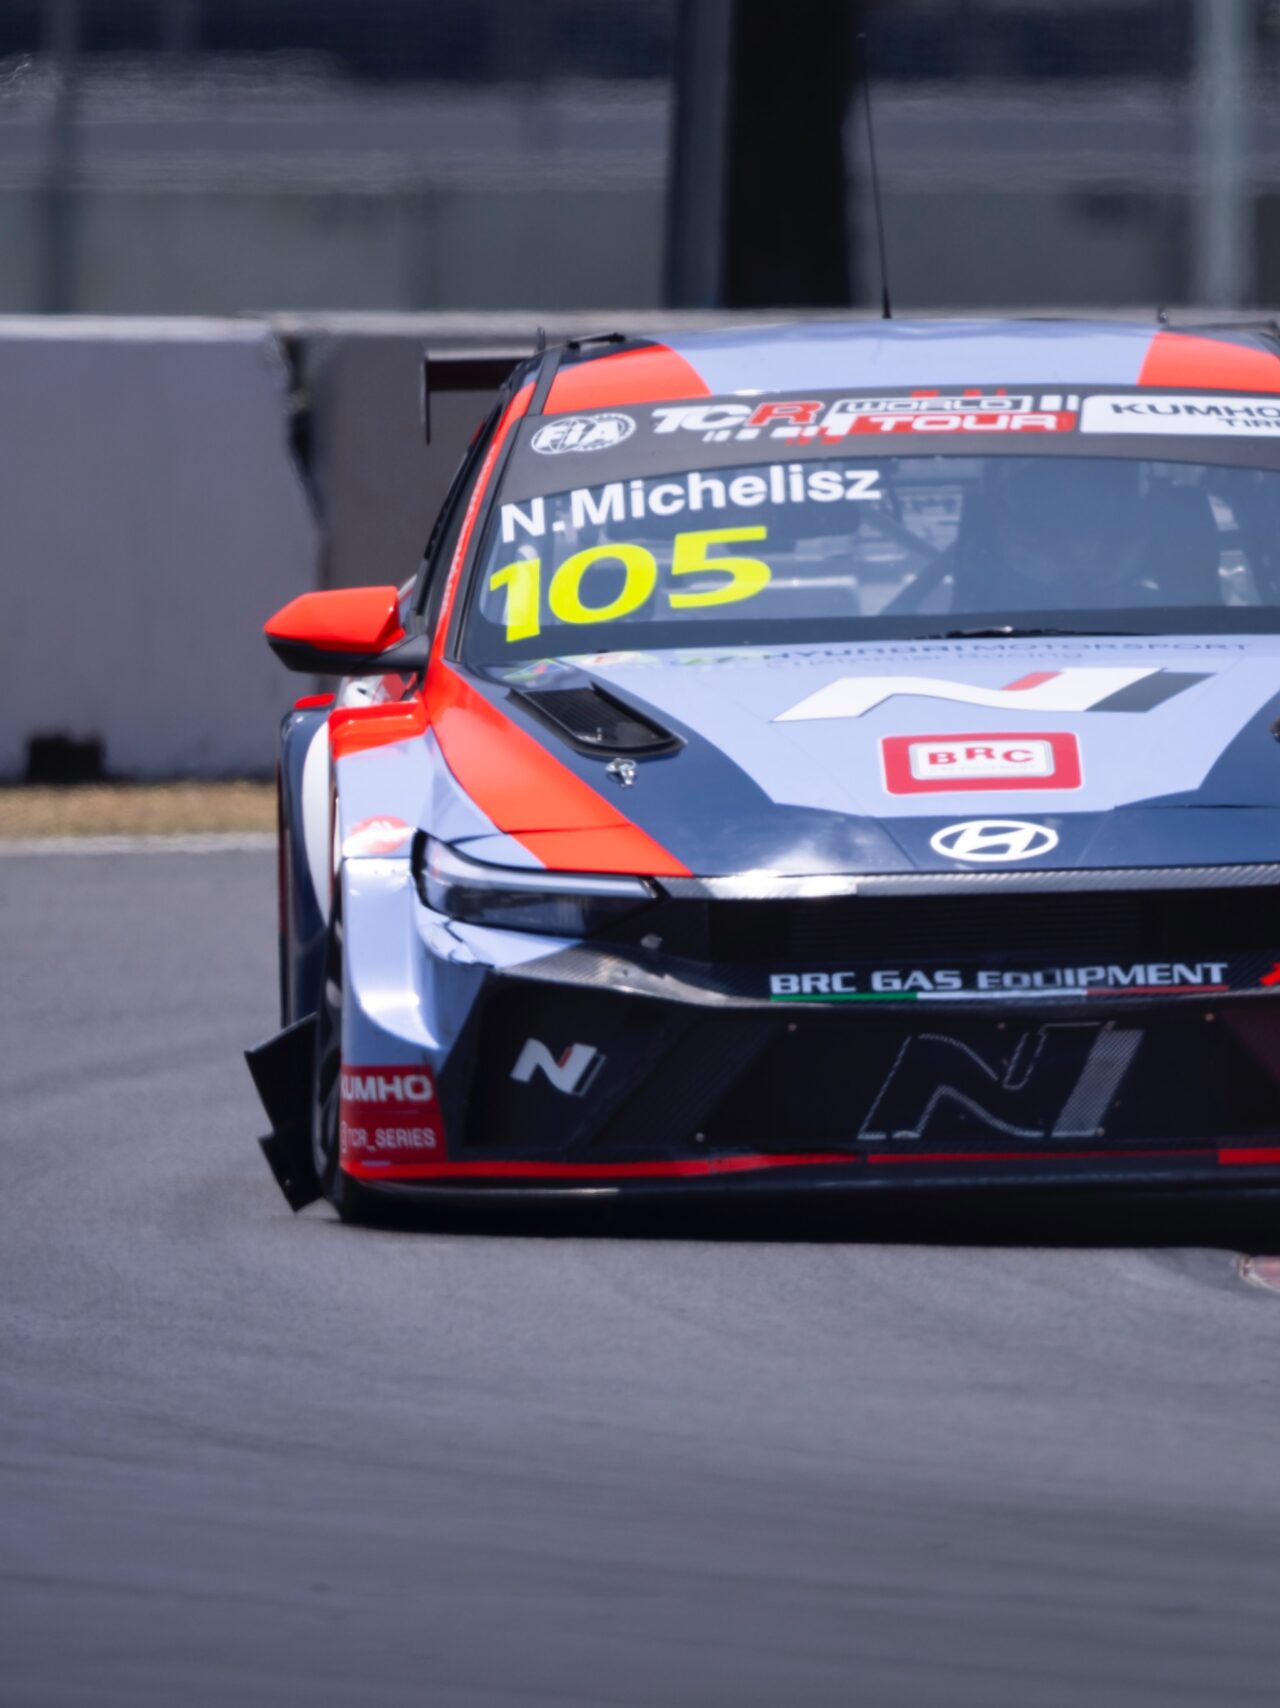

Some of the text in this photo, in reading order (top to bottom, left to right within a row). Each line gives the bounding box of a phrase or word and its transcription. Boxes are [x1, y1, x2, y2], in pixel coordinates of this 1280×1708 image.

[652, 401, 826, 434] TCR
[846, 398, 1014, 412] WORLD
[869, 414, 1058, 432] TOUR
[489, 525, 772, 643] 105
[927, 746, 1035, 765] BRC
[770, 963, 1228, 995] BRC GAS EQUIPMENT
